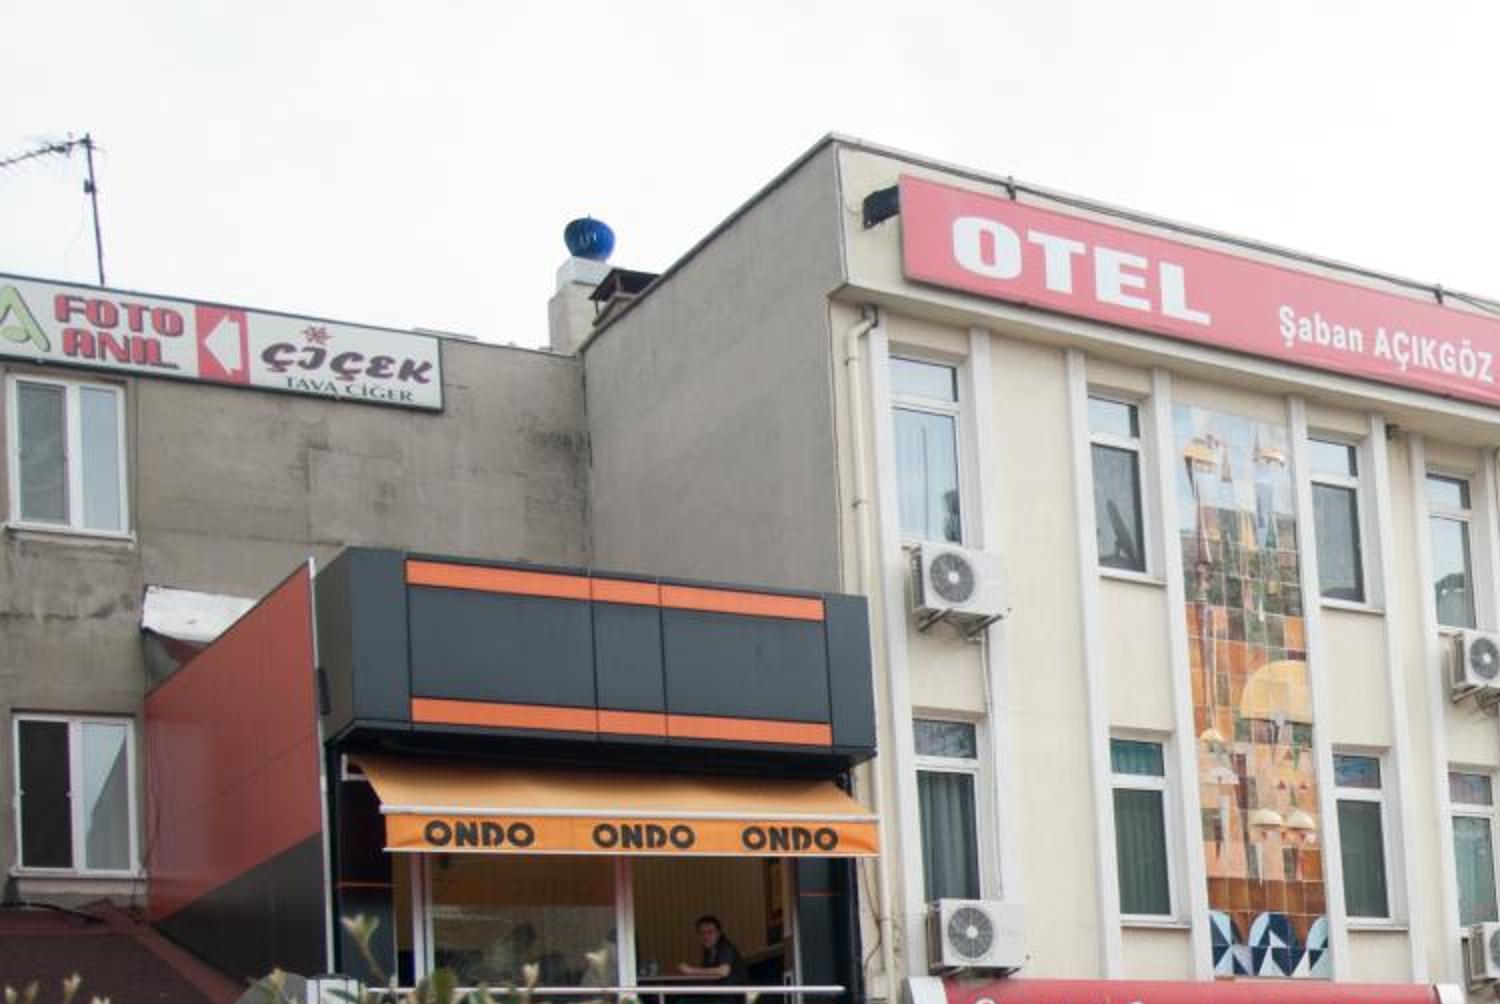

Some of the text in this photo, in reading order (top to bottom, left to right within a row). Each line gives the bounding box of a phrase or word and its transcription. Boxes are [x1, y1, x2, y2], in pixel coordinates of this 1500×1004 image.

[951, 214, 1211, 327] OTEL
[53, 293, 184, 338] FOTO
[1278, 304, 1495, 384] Şaban AÇIKGÖZ
[286, 376, 338, 395] TAVA
[423, 819, 535, 849] ONDO
[592, 822, 696, 850] ONDO
[741, 825, 840, 852] ONDO
